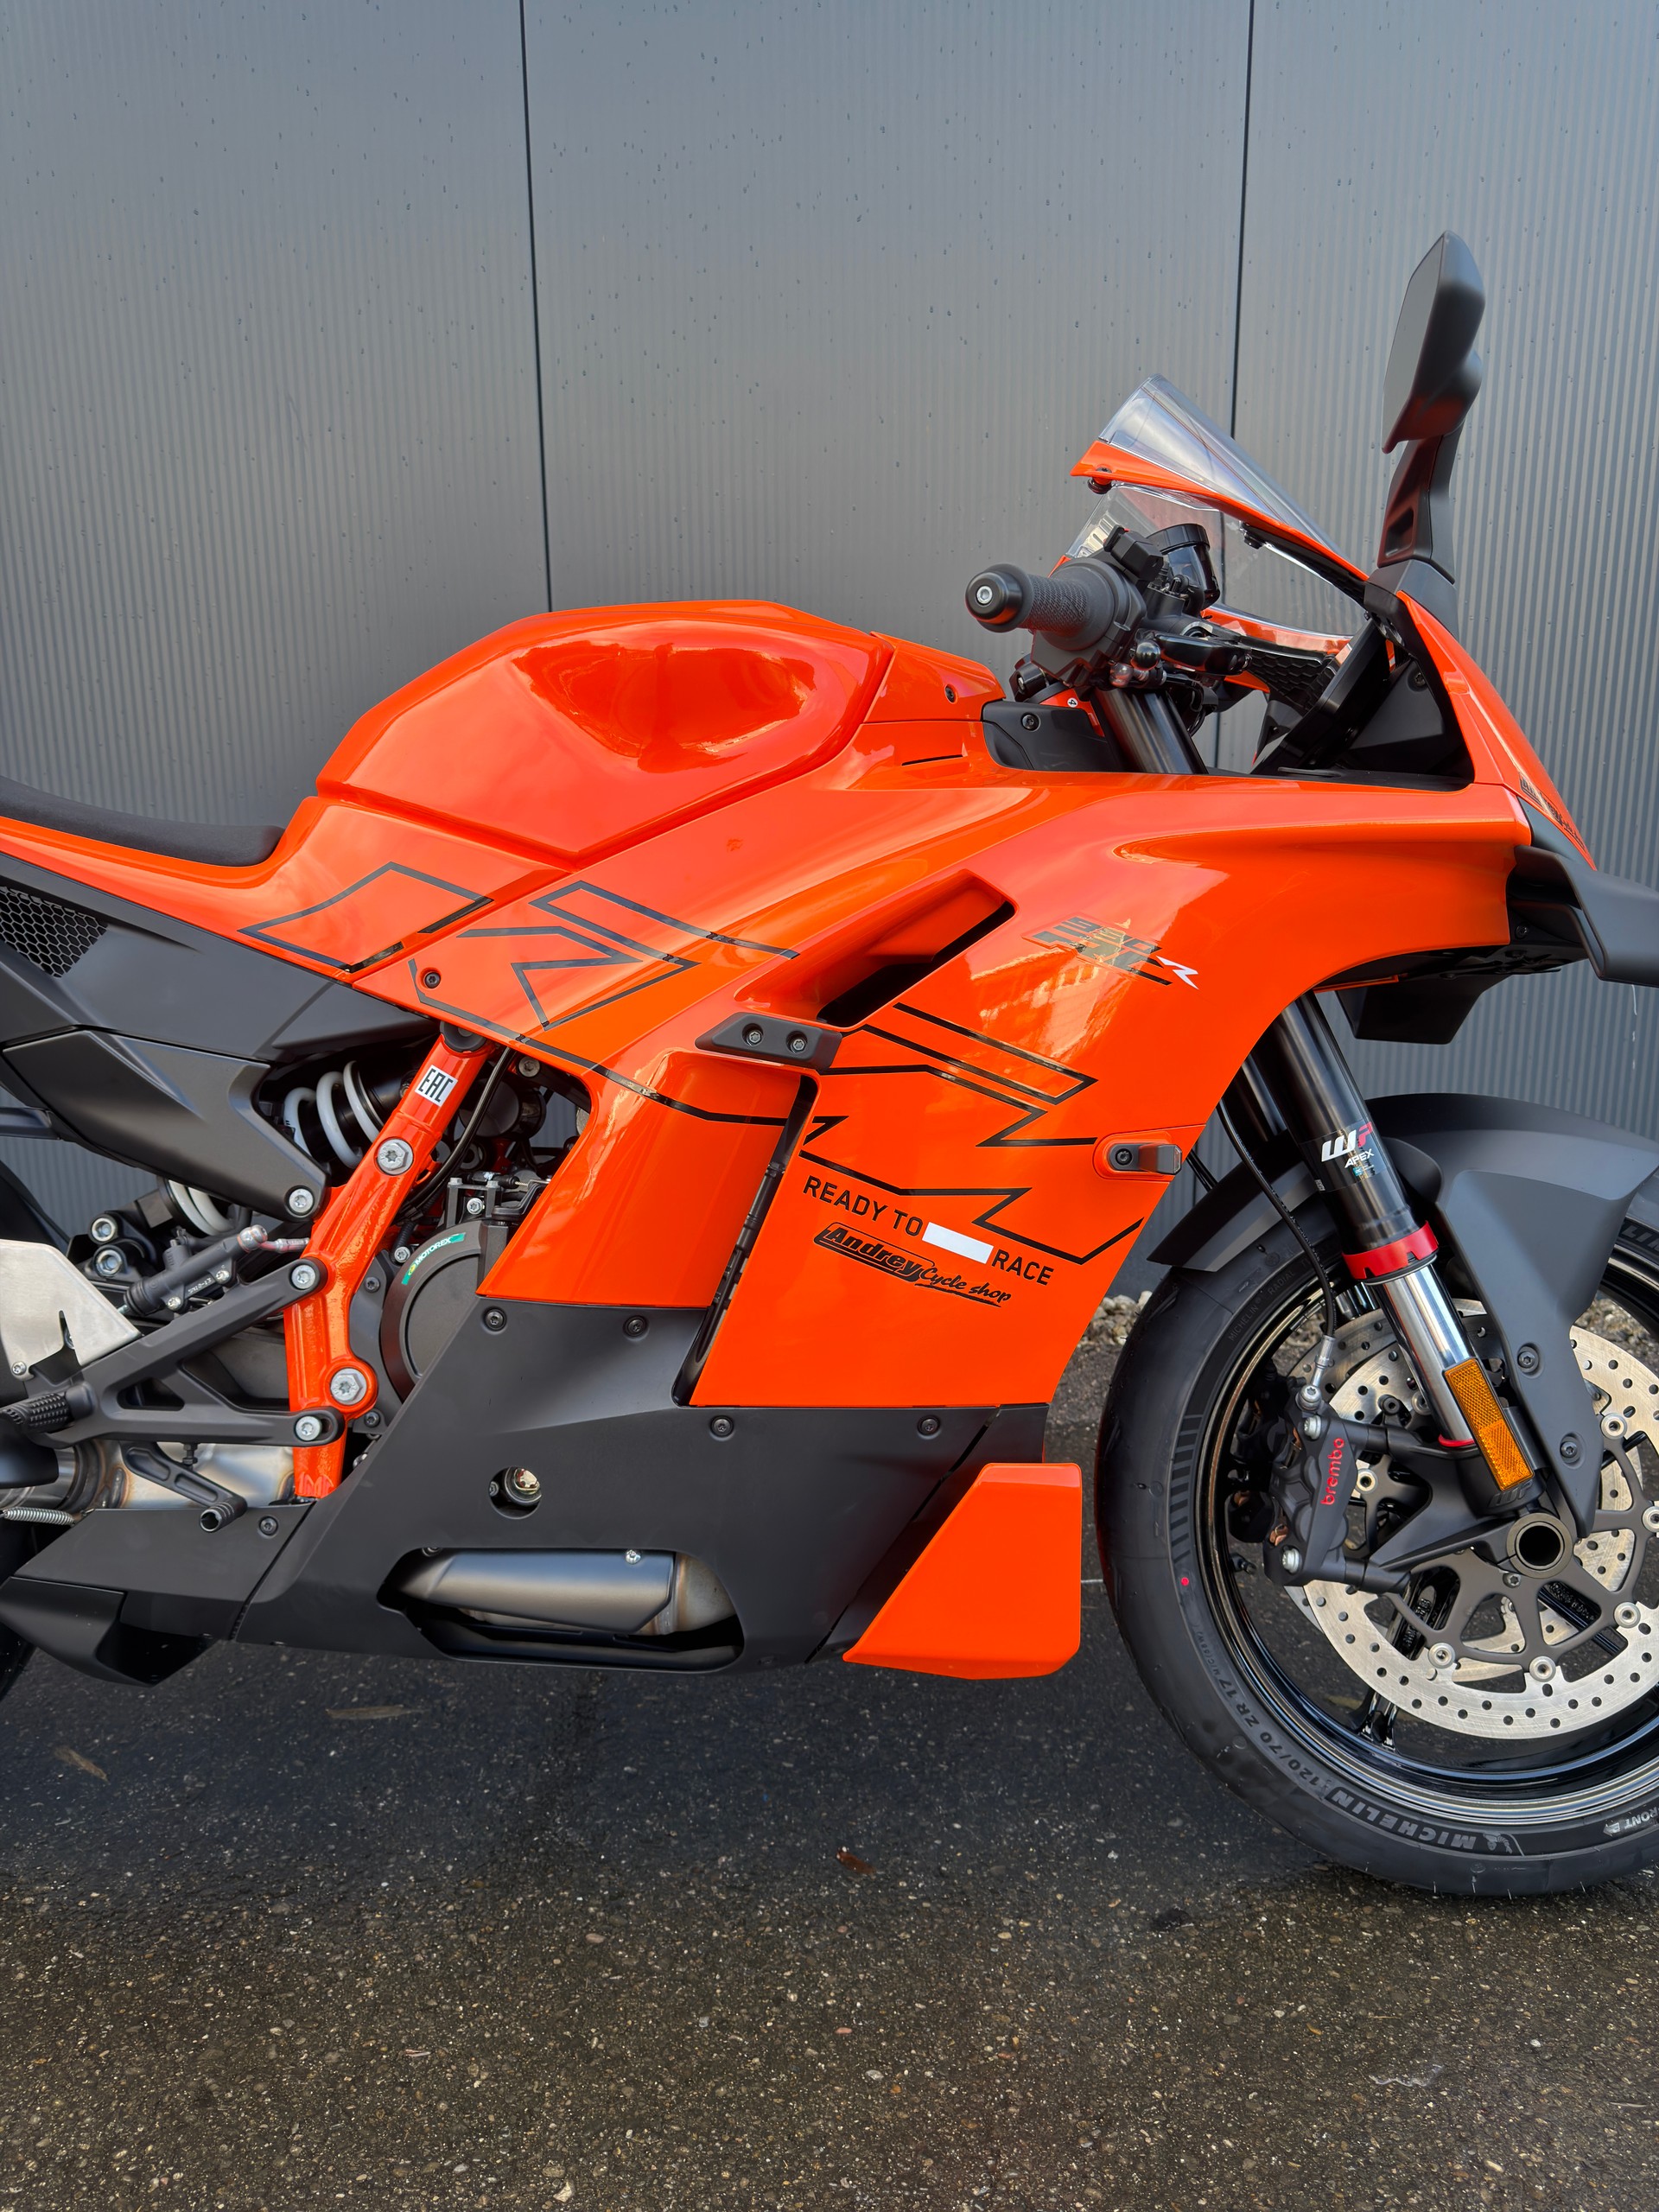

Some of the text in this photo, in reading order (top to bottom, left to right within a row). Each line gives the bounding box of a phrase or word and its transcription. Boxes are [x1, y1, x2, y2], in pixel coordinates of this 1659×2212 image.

[417, 1067, 454, 1103] EAC
[1321, 1122, 1373, 1162] WP
[1344, 1148, 1376, 1169] APEX
[803, 1174, 1054, 1286] READY TO RACE
[415, 1236, 454, 1266] MOTOREX
[824, 1226, 1012, 1304] Andrey Cycle shop
[1267, 1270, 1296, 1295] RADIAL
[1320, 1437, 1345, 1505] brembo
[1218, 1678, 1237, 1698] 17
[1236, 1702, 1260, 1727] ZR
[1259, 1731, 1318, 1786] 120/70
[1332, 1789, 1478, 1850] MICHELIN
[1624, 1806, 1659, 1830] RONT
